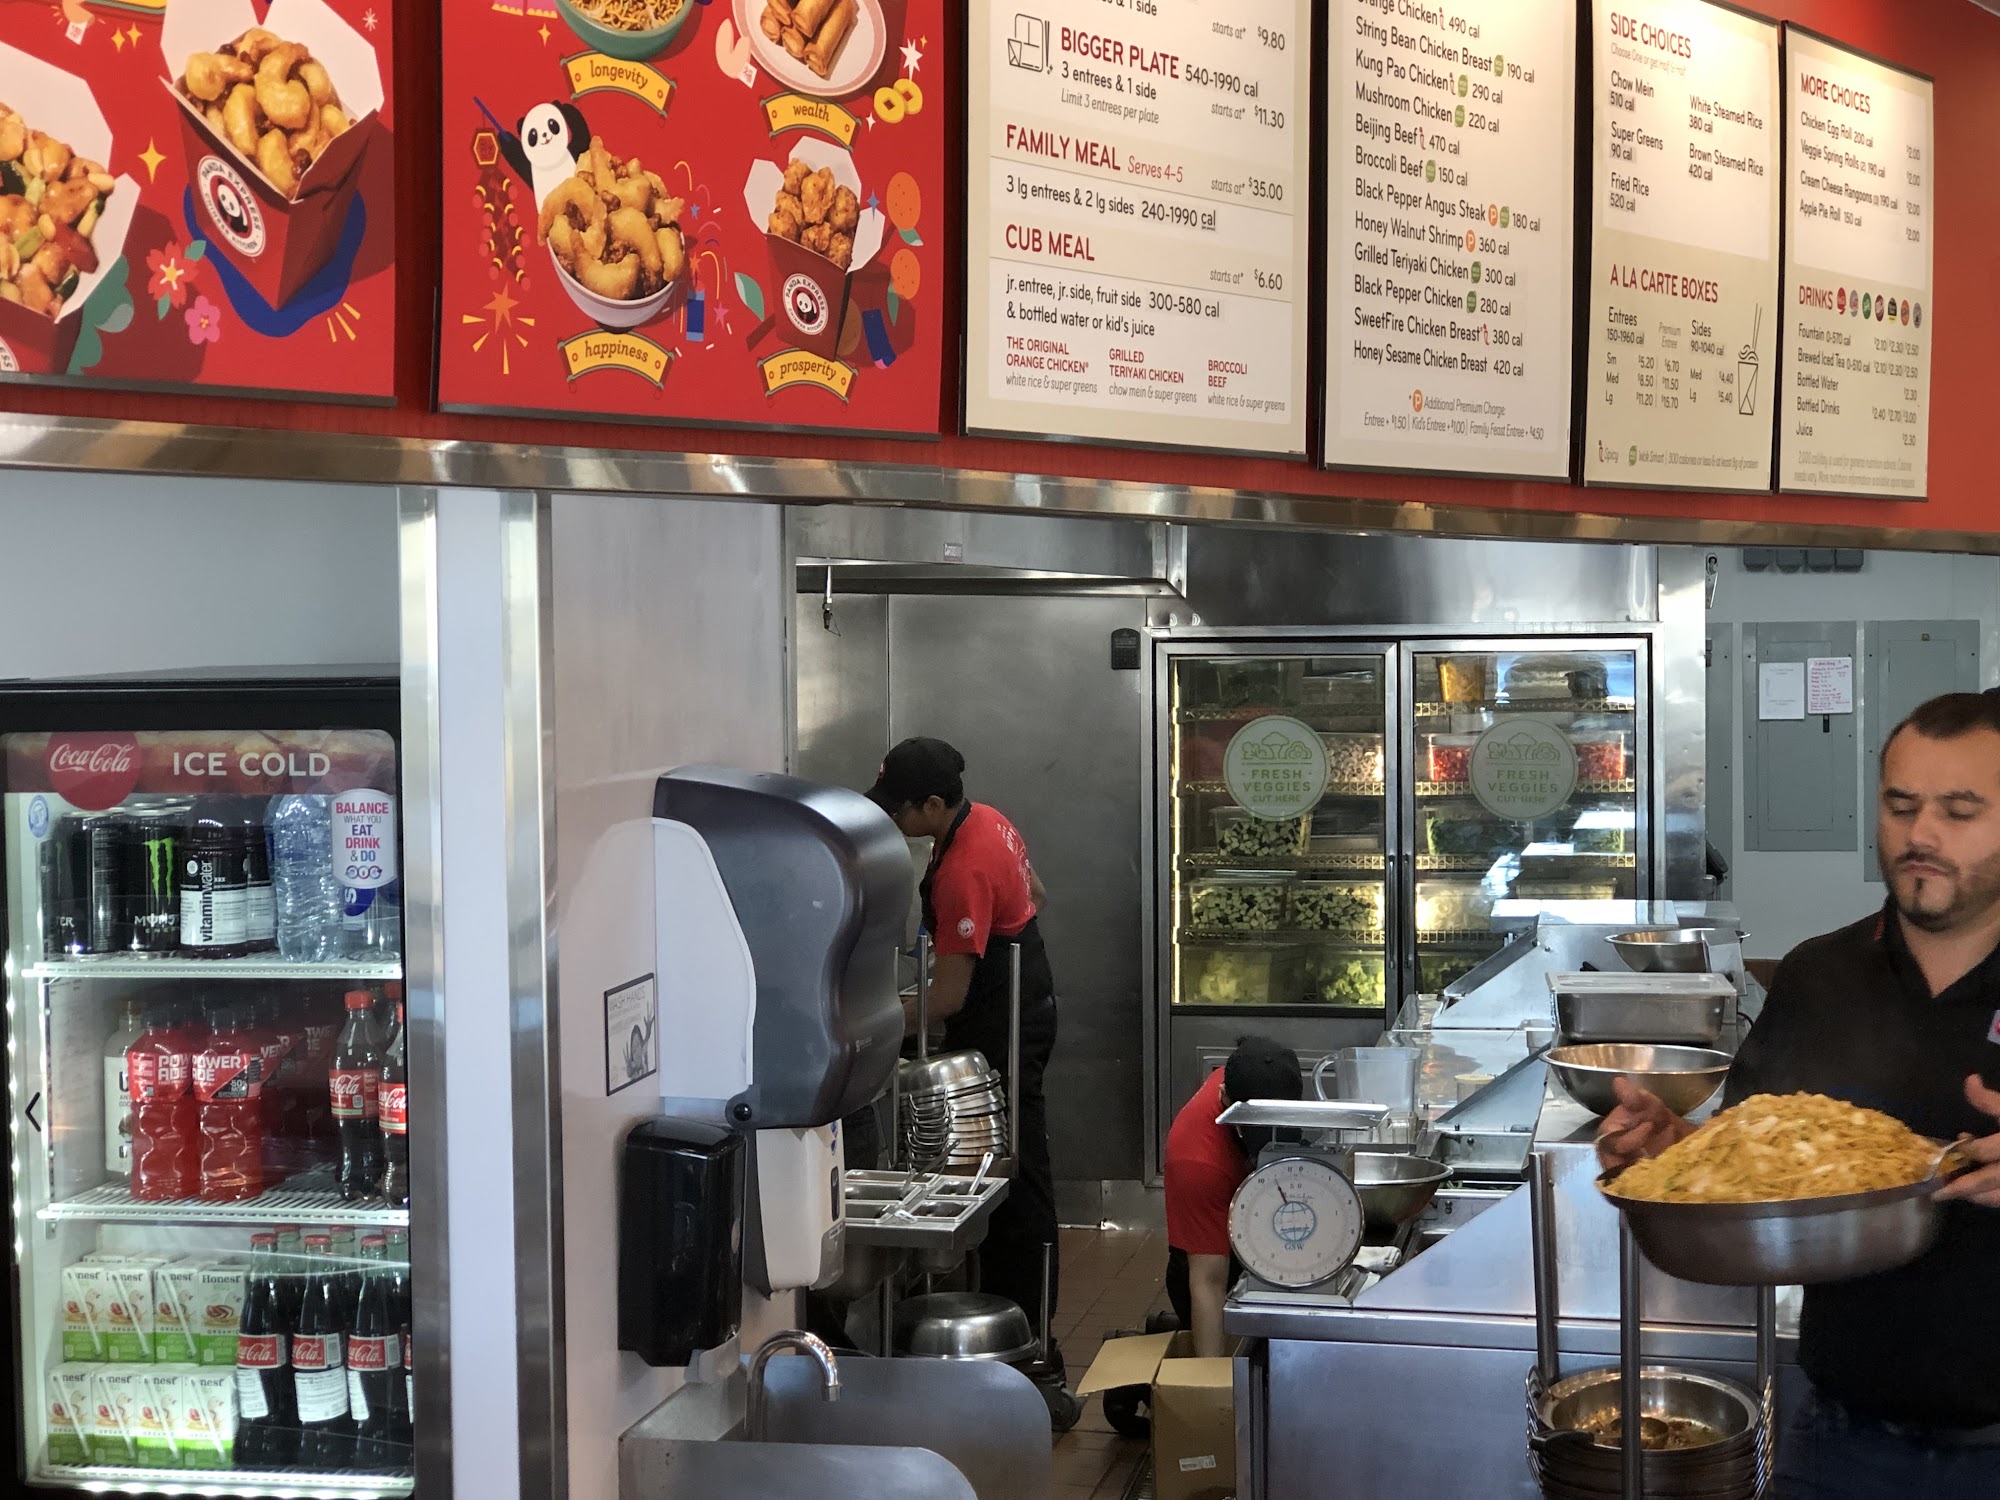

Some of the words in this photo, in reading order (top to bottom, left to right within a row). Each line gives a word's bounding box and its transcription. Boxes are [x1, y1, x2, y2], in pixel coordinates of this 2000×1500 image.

[1212, 20, 1232, 38] starts
[1257, 25, 1285, 51] $9.80
[1611, 12, 1637, 41] SIDE
[1641, 23, 1691, 59] CHOICES
[1356, 16, 1387, 46] String
[1391, 27, 1416, 50] Bean
[1419, 35, 1459, 62] Chicken
[1462, 48, 1492, 72] Breast
[1507, 63, 1521, 80] 190
[1524, 68, 1534, 83] cal
[1061, 27, 1124, 66] BIGGER
[1129, 45, 1180, 80] PLATE
[1185, 64, 1241, 93] 540-1990
[1244, 81, 1259, 98] cal
[589, 60, 649, 89] longevity
[1061, 61, 1069, 79] 3
[1073, 67, 1112, 90] entrees
[1115, 76, 1124, 92] &
[1127, 77, 1132, 94] 1
[1135, 77, 1157, 101] side
[1801, 72, 1828, 100] MORE
[1831, 84, 1870, 114] CHOICES
[792, 104, 830, 122] wealth
[1061, 88, 1083, 106] Limit
[1084, 95, 1090, 108] 3
[1091, 98, 1122, 116] entrees
[1123, 105, 1137, 121] per
[1139, 105, 1159, 124] plate
[1211, 102, 1232, 119] starts
[1254, 105, 1285, 130] $11.30
[1356, 81, 1410, 112] Mushroom
[1413, 96, 1453, 123] Chicken
[1468, 112, 1485, 130] 220
[1488, 117, 1499, 133] cal
[1356, 113, 1391, 143] Beijing
[1395, 123, 1417, 145] Beef
[1429, 136, 1446, 152] 470
[1448, 140, 1460, 155] cal
[1612, 121, 1634, 144] Super
[1636, 129, 1663, 150] Greens
[1006, 124, 1070, 160] FAMILY
[1075, 138, 1121, 171] MEAL
[1127, 156, 1162, 179] Serves
[1164, 163, 1183, 183] 4-5
[1611, 143, 1621, 158] 90
[1623, 147, 1632, 161] cal
[1689, 143, 1712, 163] Brown
[1714, 150, 1746, 172] Steamed
[1748, 158, 1764, 176] Rice
[1689, 164, 1702, 179] 420
[1704, 168, 1713, 181] cal
[1211, 178, 1232, 193] starts
[1248, 177, 1283, 201] $35.00
[1611, 173, 1630, 192] Fried
[1633, 178, 1649, 196] Rice
[1006, 175, 1014, 193] 3
[1018, 176, 1028, 199] lg
[1031, 184, 1070, 204] entrees
[1074, 188, 1082, 205] &
[1085, 190, 1093, 208] 2
[1096, 190, 1106, 214] lg
[1109, 192, 1134, 216] sides
[1141, 201, 1197, 227] 240-1990
[1201, 210, 1215, 227] cal
[1356, 178, 1383, 201] Black
[1387, 185, 1422, 210] Pepper
[1425, 193, 1456, 218] Angus
[1459, 200, 1486, 221] Steak
[1513, 213, 1527, 229] 180
[1530, 218, 1540, 232] cal
[1610, 193, 1624, 208] 520
[1626, 197, 1635, 212] cal
[1006, 224, 1043, 252] CUB
[1049, 231, 1095, 261] MEAL
[1356, 211, 1388, 238] Honey
[1391, 217, 1426, 241] Walnut
[1429, 226, 1464, 252] Shrimp
[1479, 238, 1496, 253] 360
[1498, 241, 1510, 256] cal
[1355, 243, 1388, 266] Grilled
[1391, 249, 1427, 274] Teriyaki
[1430, 257, 1468, 280] Chicken
[1485, 269, 1503, 284] 300
[1505, 272, 1516, 286] cal
[1210, 268, 1232, 283] starts
[1254, 268, 1283, 291] $6.60
[1610, 264, 1619, 286] A
[1622, 266, 1637, 289] LA
[1641, 269, 1678, 296] CARTE
[1681, 277, 1718, 303] BOXES
[786, 279, 801, 297] PANDA
[803, 279, 825, 310] EXPRESS
[1096, 288, 1118, 304] fruit
[1121, 292, 1141, 308] side
[1149, 292, 1201, 315] 300-580
[1204, 301, 1219, 318] cal
[1799, 285, 1833, 310] DRINKS
[1007, 305, 1015, 319] &
[1019, 307, 1057, 324] bottled
[1060, 314, 1089, 329] water
[1092, 317, 1102, 330] or
[1106, 315, 1128, 333] kid's
[1131, 319, 1155, 337] juice
[1609, 307, 1637, 327] Entrees
[1007, 336, 1024, 351] THE
[1027, 338, 1069, 355] ORIGINAL
[1636, 334, 1644, 345] cal
[584, 340, 649, 363] happiness
[1006, 354, 1044, 370] ORANGE
[1109, 348, 1144, 363] GRILLED
[779, 359, 837, 380] prosperity
[1110, 365, 1146, 380] TERIYAKI
[1149, 370, 1184, 384] CHICKEN
[1208, 360, 1247, 375] BROCCOLI
[1006, 374, 1026, 388] white
[1029, 377, 1041, 389] rice
[1043, 377, 1049, 389] &
[1051, 378, 1071, 393] super
[1073, 381, 1097, 394] greens
[1208, 375, 1227, 388] BEEF
[1797, 372, 1819, 389] Bottled
[1821, 376, 1839, 391] Water
[49, 743, 134, 773] Coca-Cola
[173, 752, 227, 776] ICE
[240, 752, 331, 777] COLD
[1252, 770, 1301, 779] FRESH
[1497, 770, 1549, 779] FRESH
[1243, 782, 1311, 791] VEGGIES
[1488, 782, 1558, 792] VEGGIES
[336, 802, 389, 814] BALANCE
[344, 815, 364, 823] WHAT
[346, 837, 380, 848] DRINK
[350, 850, 358, 861] &
[361, 850, 376, 861] DO
[199, 860, 213, 943] vitaminwater
[202, 1275, 241, 1283] Honest
